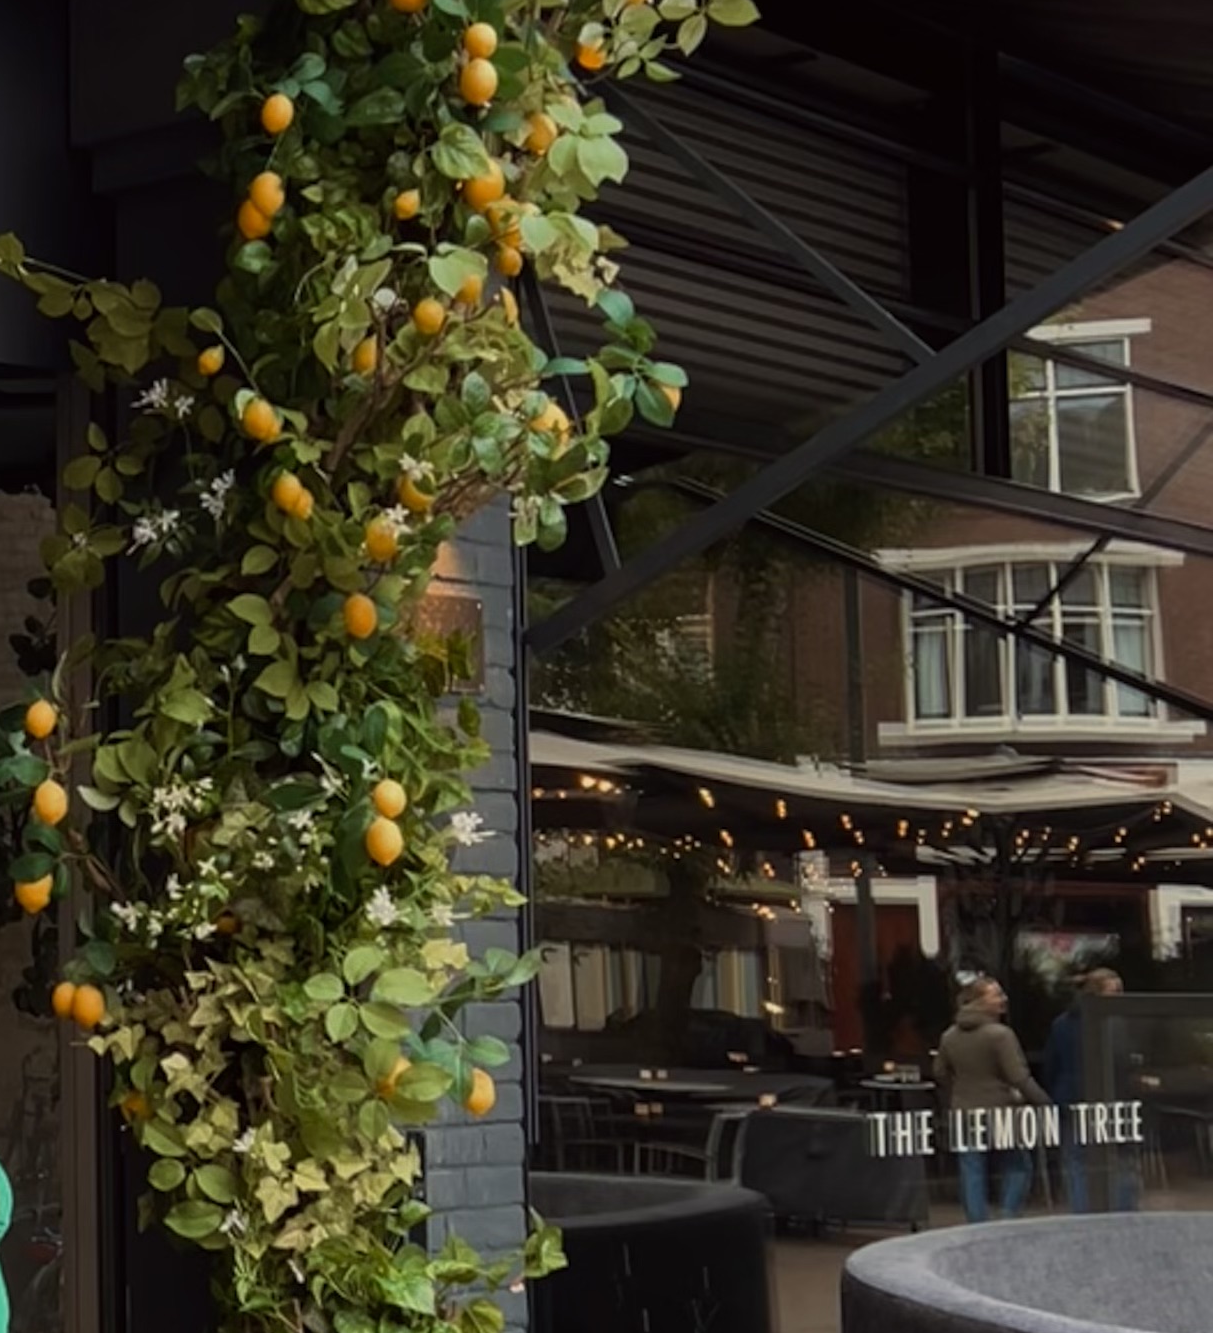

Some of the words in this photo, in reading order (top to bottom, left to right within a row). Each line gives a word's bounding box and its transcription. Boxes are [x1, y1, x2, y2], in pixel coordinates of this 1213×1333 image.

[871, 1110, 935, 1158] THE
[953, 1104, 1060, 1153] LEMON
[1074, 1100, 1144, 1146] TREE
